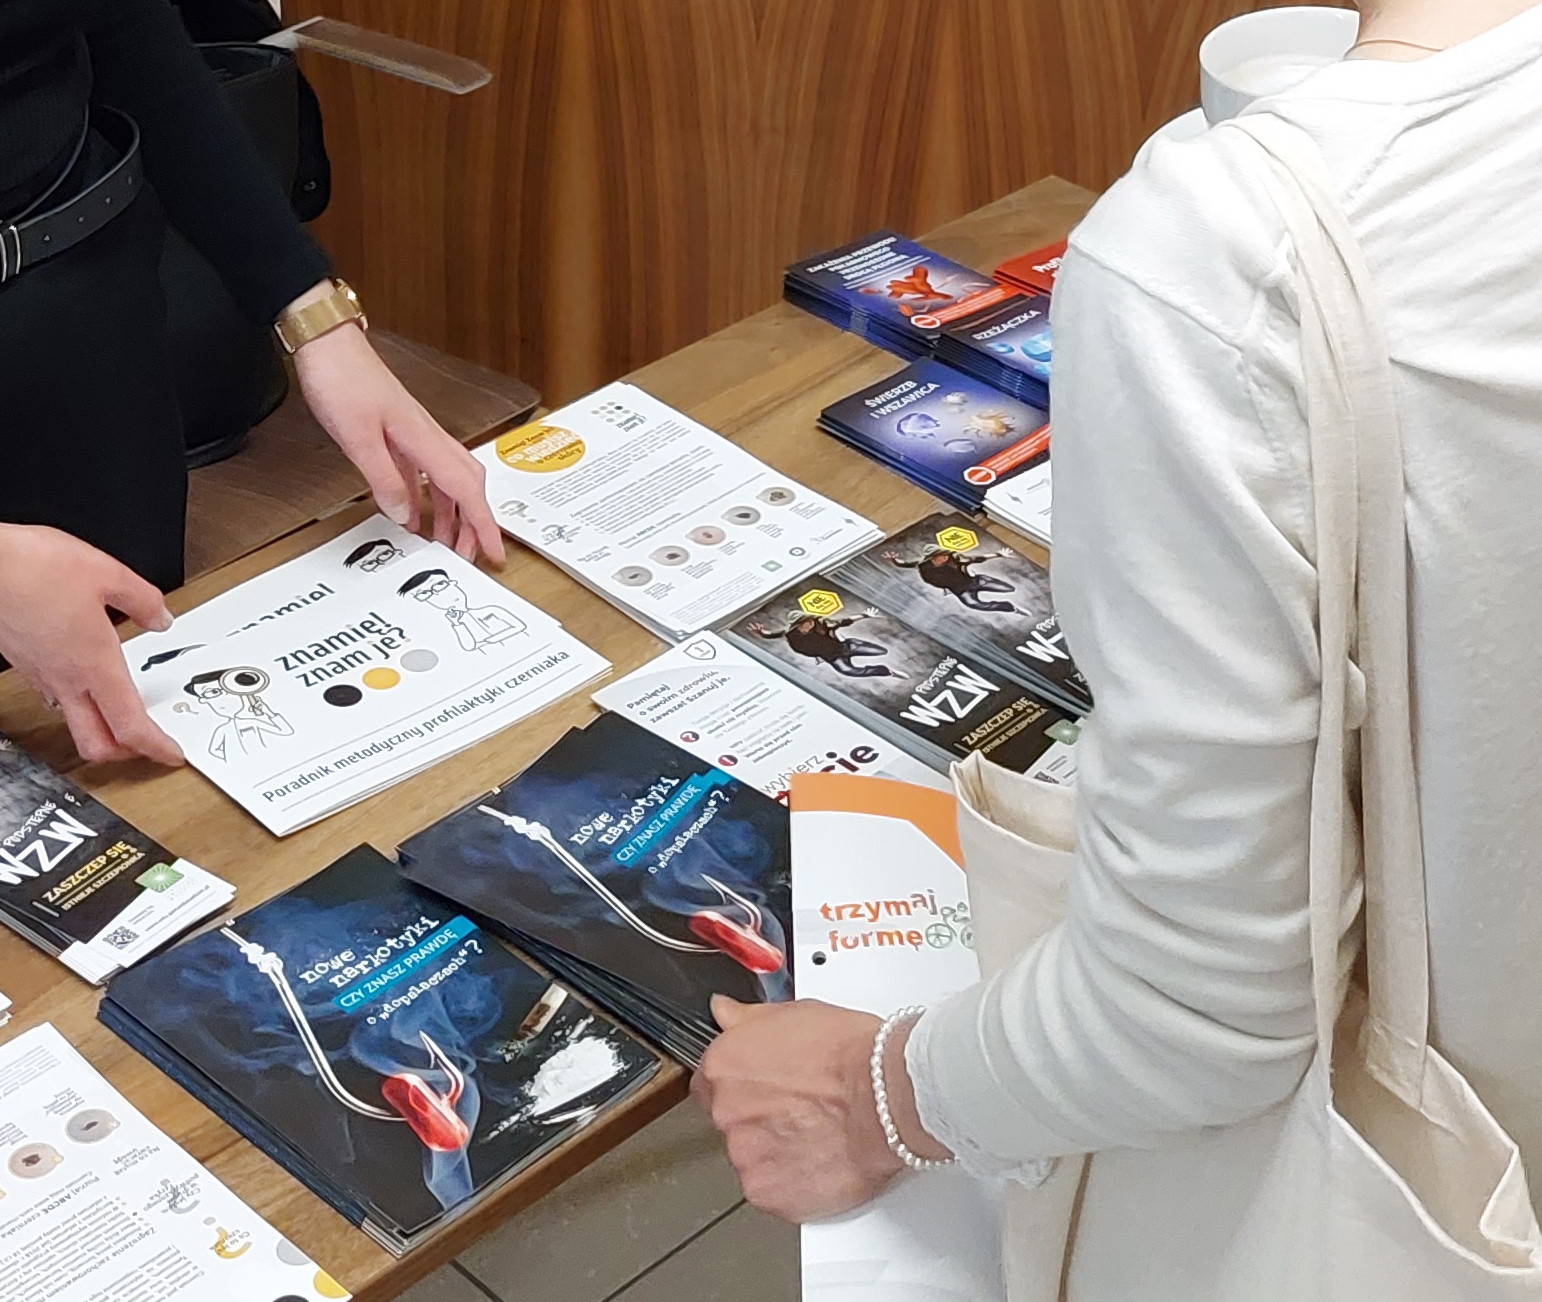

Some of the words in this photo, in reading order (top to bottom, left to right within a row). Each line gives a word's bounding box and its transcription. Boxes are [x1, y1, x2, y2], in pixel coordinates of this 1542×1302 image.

[971, 310, 1042, 340] RZEŻĄCZKA
[864, 380, 917, 409] ŚWIERZB
[877, 382, 940, 416] WSZAWICA
[273, 612, 392, 671] znamię!
[295, 650, 373, 688] znam
[367, 626, 411, 660] je?
[627, 684, 670, 709] Pamiętaj
[647, 692, 679, 712] swoim
[685, 681, 719, 702] Szanuj
[900, 664, 1000, 727] WZW
[262, 764, 333, 803] Poradnik
[334, 723, 423, 770] metodyczny
[422, 683, 506, 737] profilaktyki
[505, 649, 570, 691] czerniaka
[961, 708, 1014, 745] ZASZCZEP
[762, 754, 824, 794] wybierz
[3, 799, 57, 847] PODSTĘPNE
[569, 810, 615, 846] nowe
[598, 776, 680, 845] narkotyki
[616, 841, 637, 862] CZY
[634, 818, 666, 848] ZNASZ
[660, 784, 702, 822] PRAWDĘ
[42, 855, 107, 903] ZASZCZEP
[106, 841, 131, 859] SIĘ
[93, 852, 146, 888] SZCZEPIONKA
[647, 866, 658, 874] o
[820, 889, 938, 923] trzymaj
[329, 916, 441, 988] narkotyki
[827, 927, 924, 952] formę
[299, 948, 356, 984] nowe
[339, 989, 365, 1008] CZY
[363, 964, 406, 994] ZNASZ
[404, 928, 458, 969] PRAWDĘ
[366, 1016, 377, 1025] o
[40, 1192, 72, 1215] ABCDE
[110, 1224, 155, 1259] Zagrożenie
[45, 1253, 110, 1301] zachorowaniem
